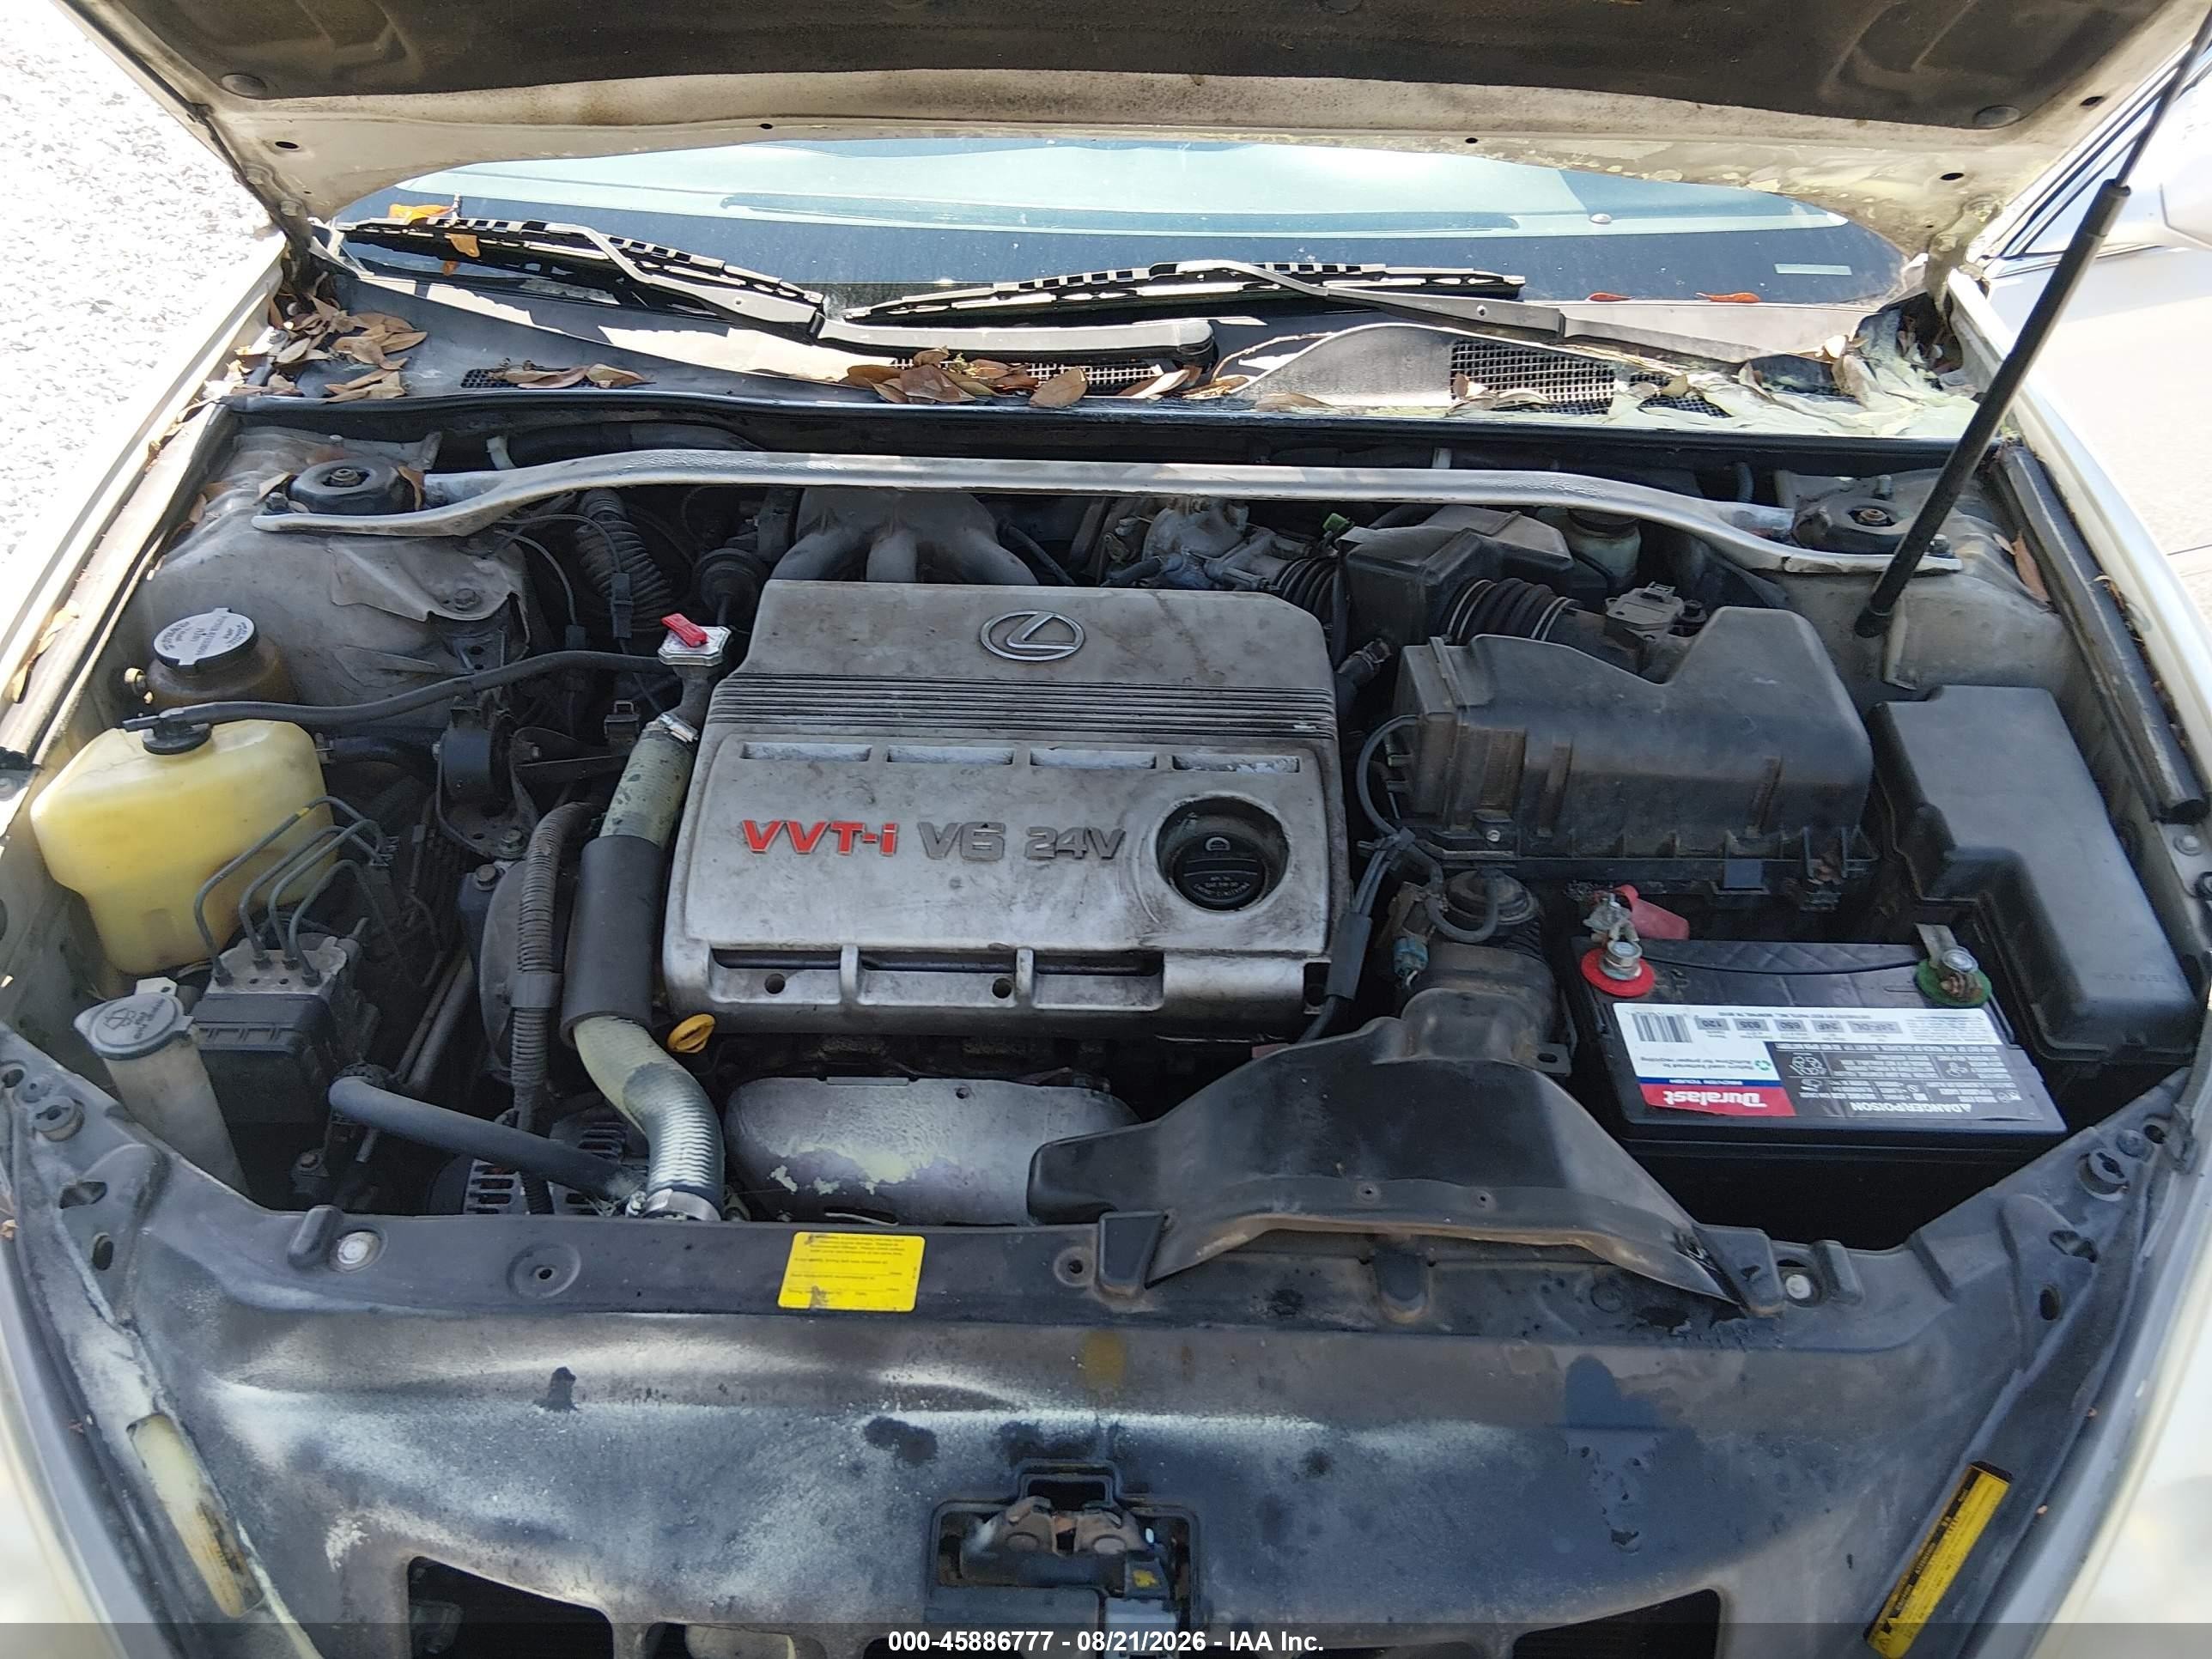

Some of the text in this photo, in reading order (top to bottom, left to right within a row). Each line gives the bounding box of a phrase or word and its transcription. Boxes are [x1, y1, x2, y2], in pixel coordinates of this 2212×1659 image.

[742, 819, 1126, 860] VVT-i V6 24V
[1701, 1019, 1722, 1028] 120
[1662, 1091, 1768, 1108] Duralast
